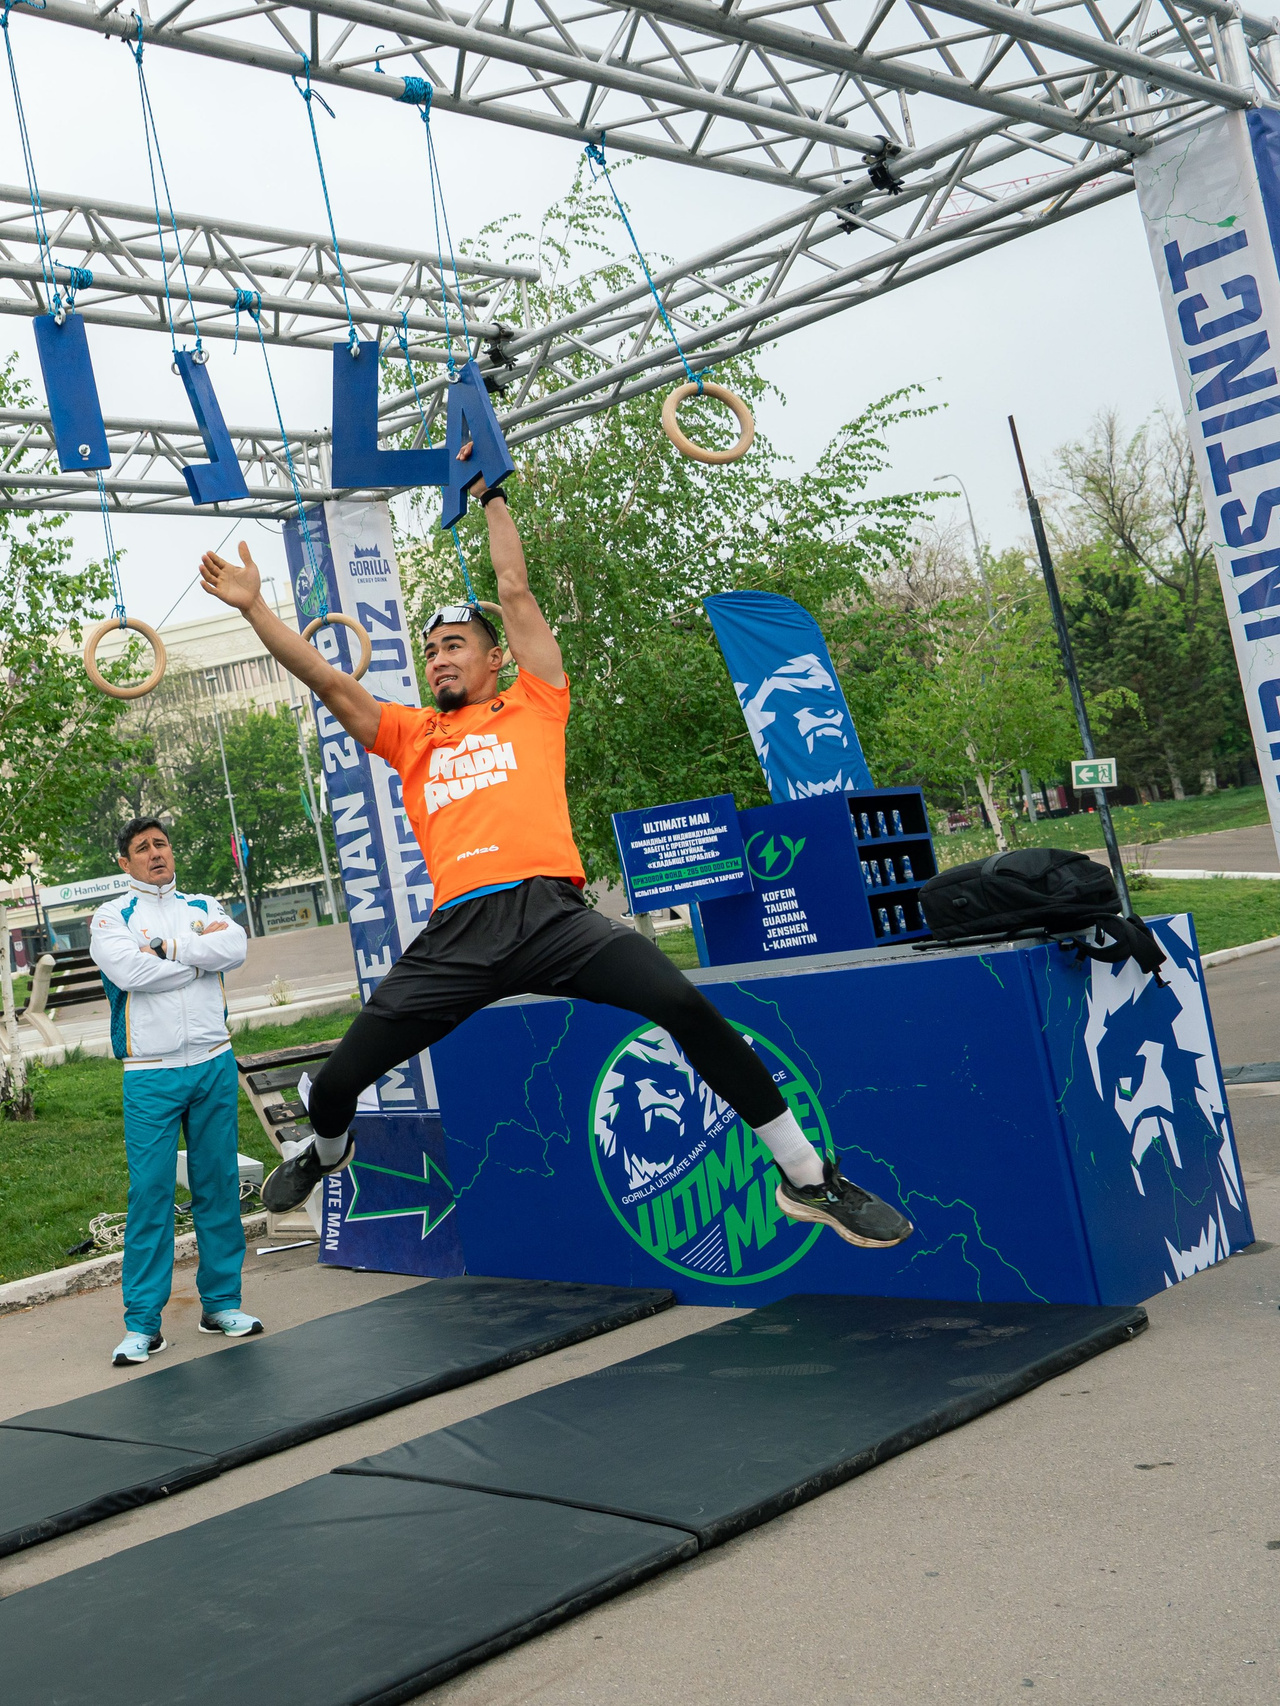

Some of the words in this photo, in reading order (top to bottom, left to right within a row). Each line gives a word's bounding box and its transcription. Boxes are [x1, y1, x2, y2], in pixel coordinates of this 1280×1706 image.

[349, 559, 391, 576] GORILLA
[311, 627, 360, 774] 206
[424, 771, 508, 815] RUN
[643, 816, 688, 834] ULTIMATE
[689, 812, 710, 826] MAN
[631, 836, 667, 849] КОМАНДНЫЕ
[331, 791, 386, 924] MAN
[633, 871, 664, 885] ПРИЗОВОЙ
[664, 870, 683, 879] ФОНД
[74, 884, 111, 896] Hamkor
[761, 887, 796, 902] KOFEIN
[764, 899, 799, 914] TAURIN
[267, 914, 297, 925] ranked
[762, 910, 807, 927] GUARANA
[766, 922, 809, 938] JENSHEN
[762, 933, 818, 951] L-KARNITIN
[622, 1184, 657, 1204] GORILLA
[655, 1158, 691, 1188] ULTIMATE
[707, 1121, 724, 1138] THE
[325, 1212, 341, 1251] MAN
